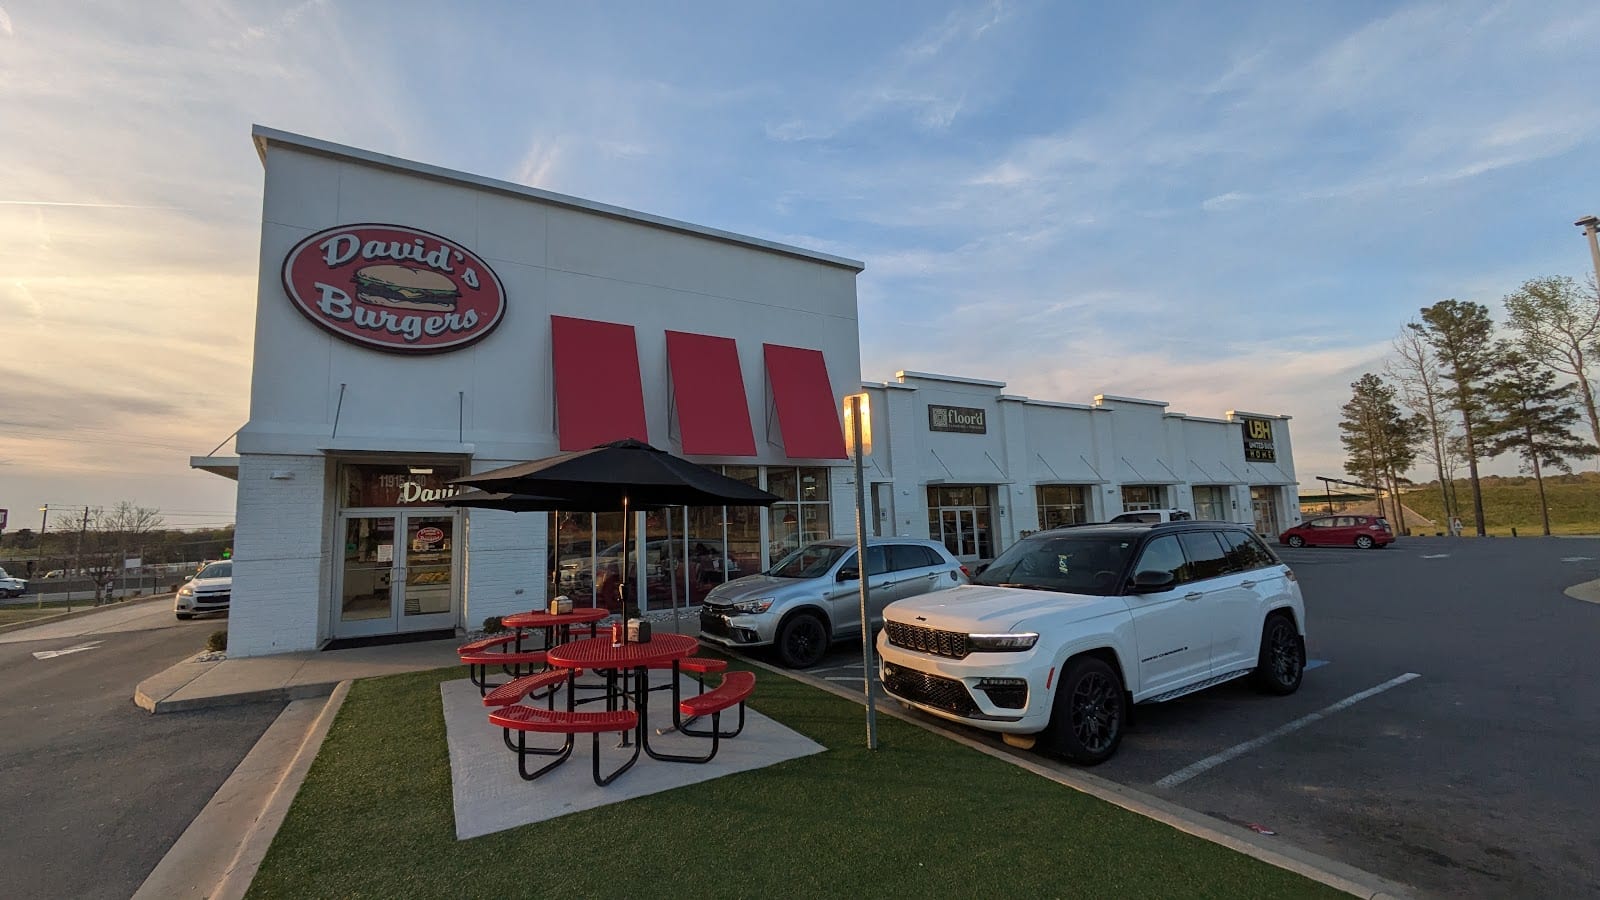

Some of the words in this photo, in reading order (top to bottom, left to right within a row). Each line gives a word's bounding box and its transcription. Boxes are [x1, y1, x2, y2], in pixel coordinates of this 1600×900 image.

[319, 233, 480, 289] David's
[314, 281, 479, 342] Burgers
[948, 409, 984, 426] floor'd
[1248, 420, 1271, 440] UBH
[399, 481, 460, 502] Davi
